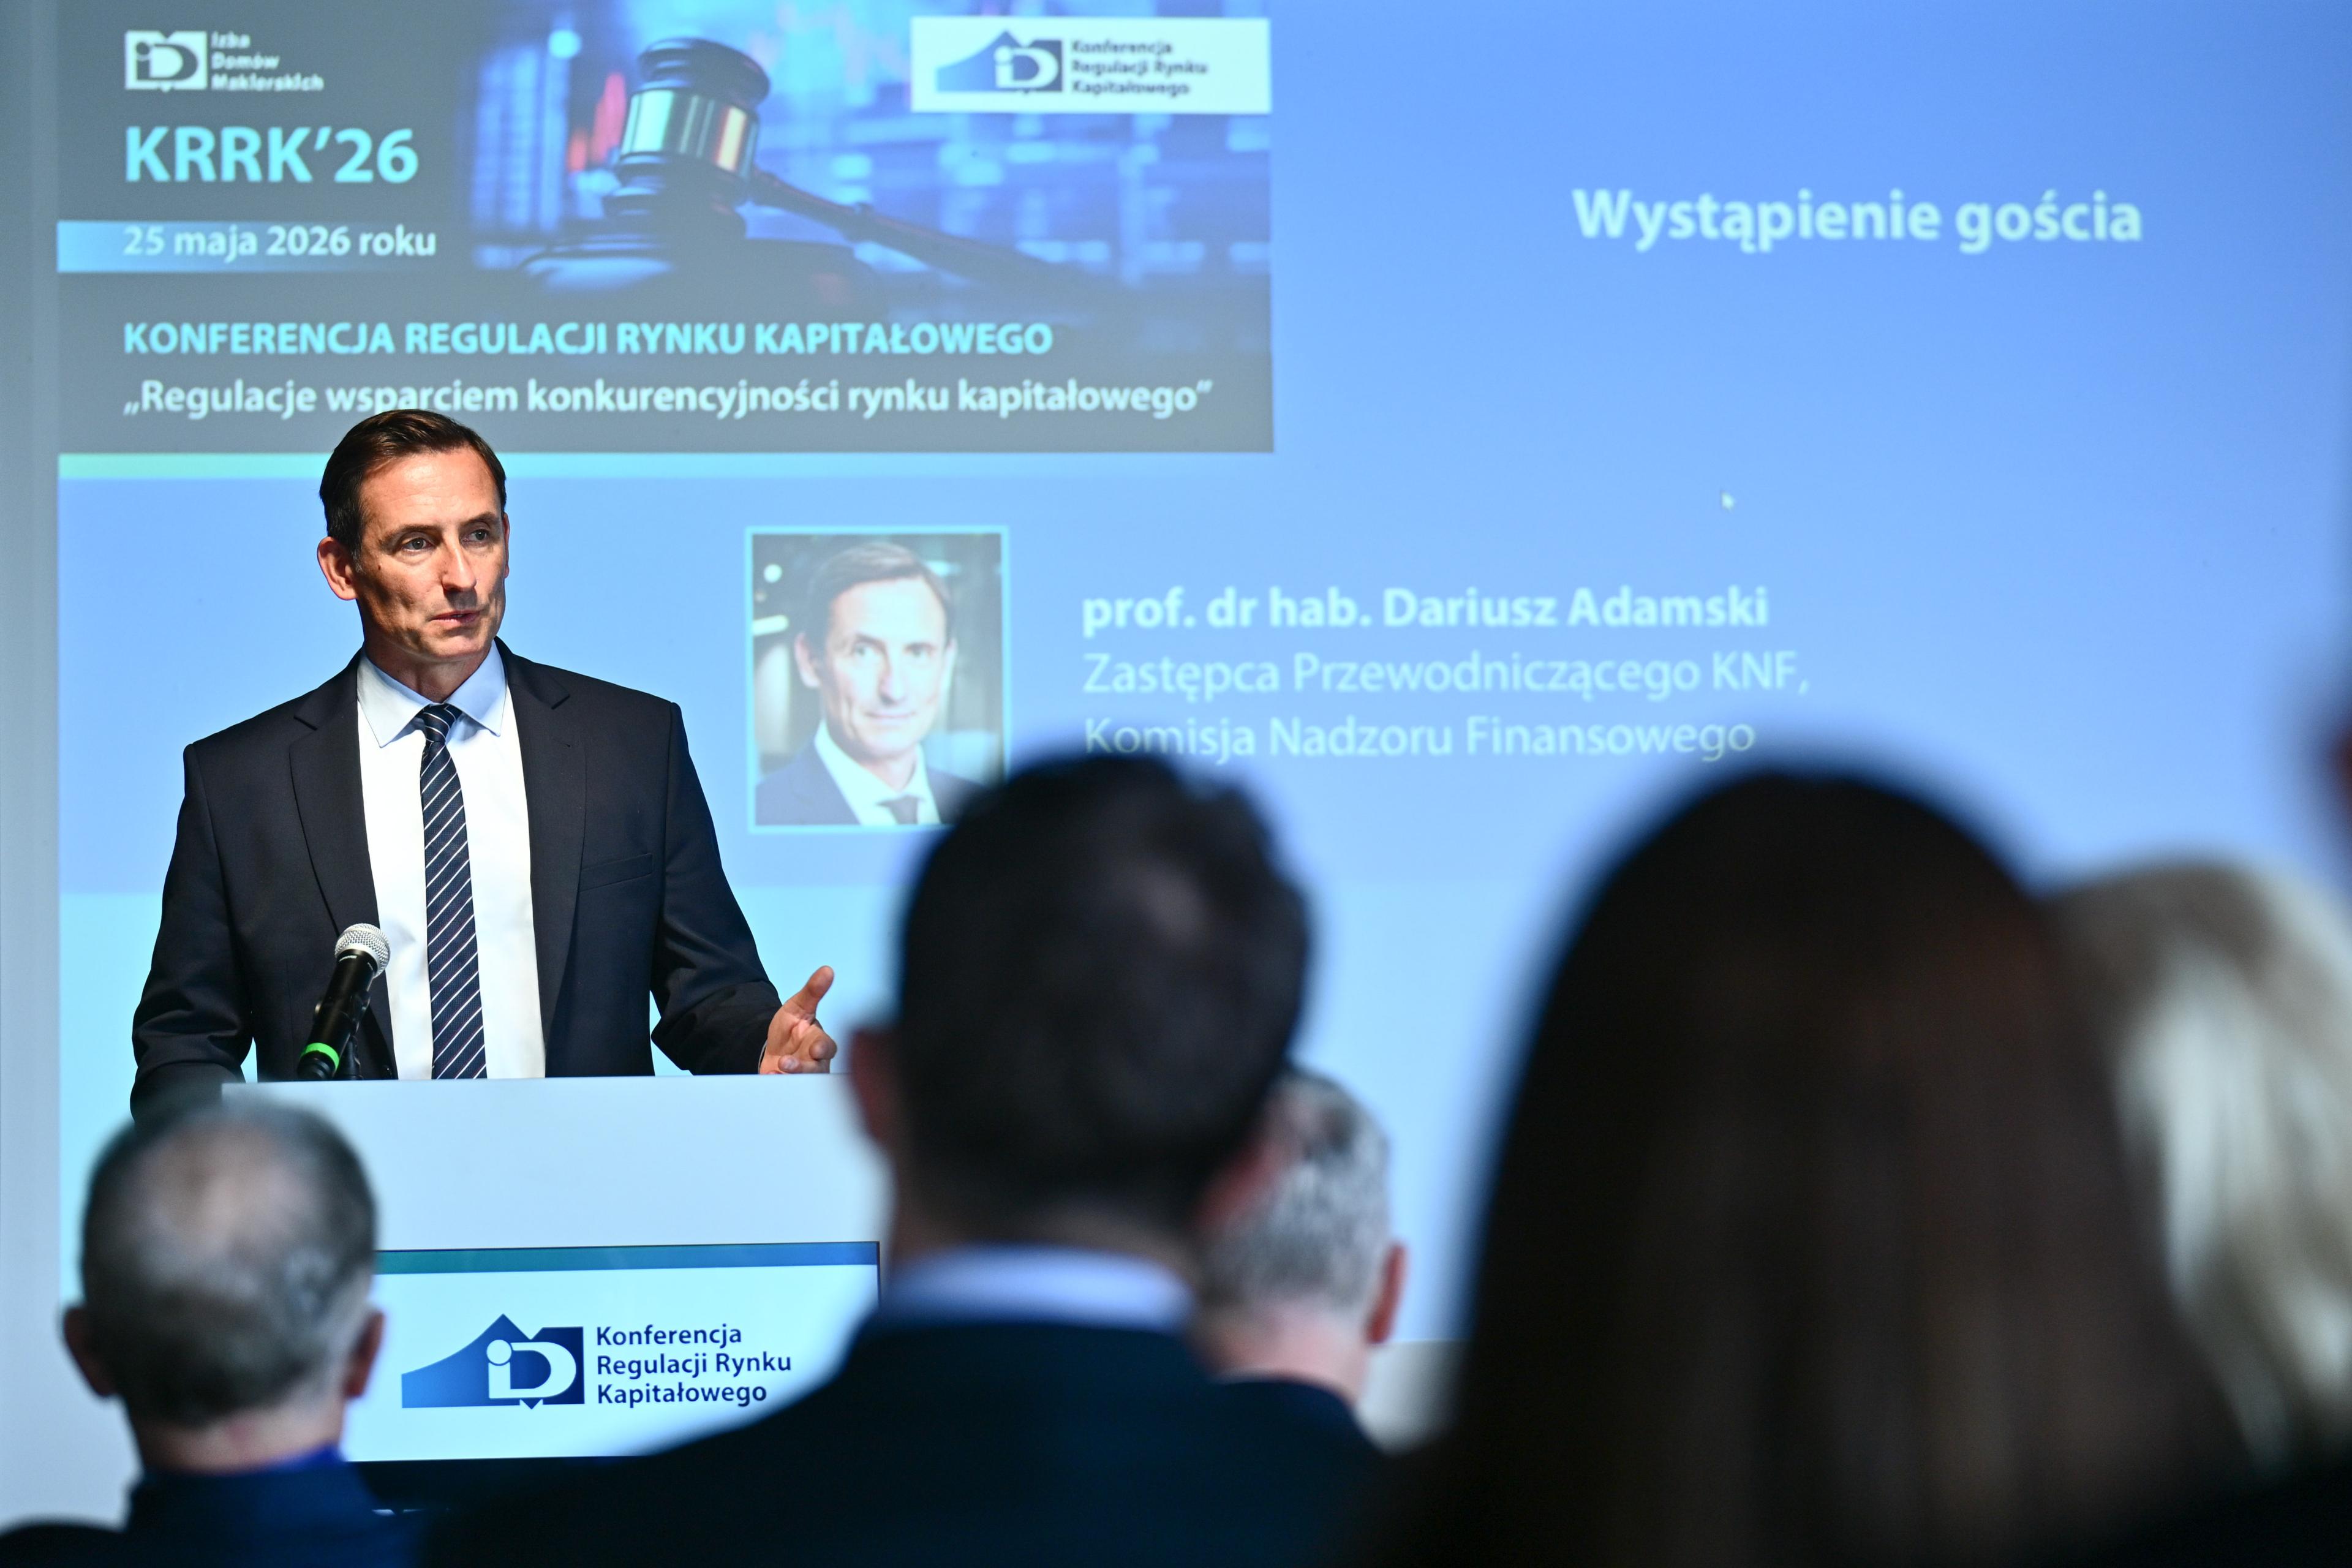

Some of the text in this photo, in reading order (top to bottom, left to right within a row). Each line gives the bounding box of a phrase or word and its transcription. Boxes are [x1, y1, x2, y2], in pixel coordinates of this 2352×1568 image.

[1072, 40, 1173, 56] Konferencja
[1072, 59, 1148, 77] Regulacji
[1572, 188, 2142, 254] Wystąpienie gościa
[123, 224, 437, 263] 25 maja 2026 roku
[124, 322, 1054, 356] KONFERENCJA REGULACJI RYNKU KAPITAŁOWEGO
[325, 379, 519, 415] wsparciem
[527, 378, 839, 420] konkurencyjności
[848, 378, 949, 419] rynku
[1082, 586, 1768, 637] prof. dr hab. Dariusz Adamski
[1082, 650, 1809, 703] Zastępca Przewodniczącego KNF,
[1084, 715, 1755, 766] Komisja Nadzoru Finansowego
[597, 1323, 742, 1349] Konferencja
[597, 1351, 792, 1379] Regulacji Rynku
[598, 1382, 767, 1408] Kapitałowego
